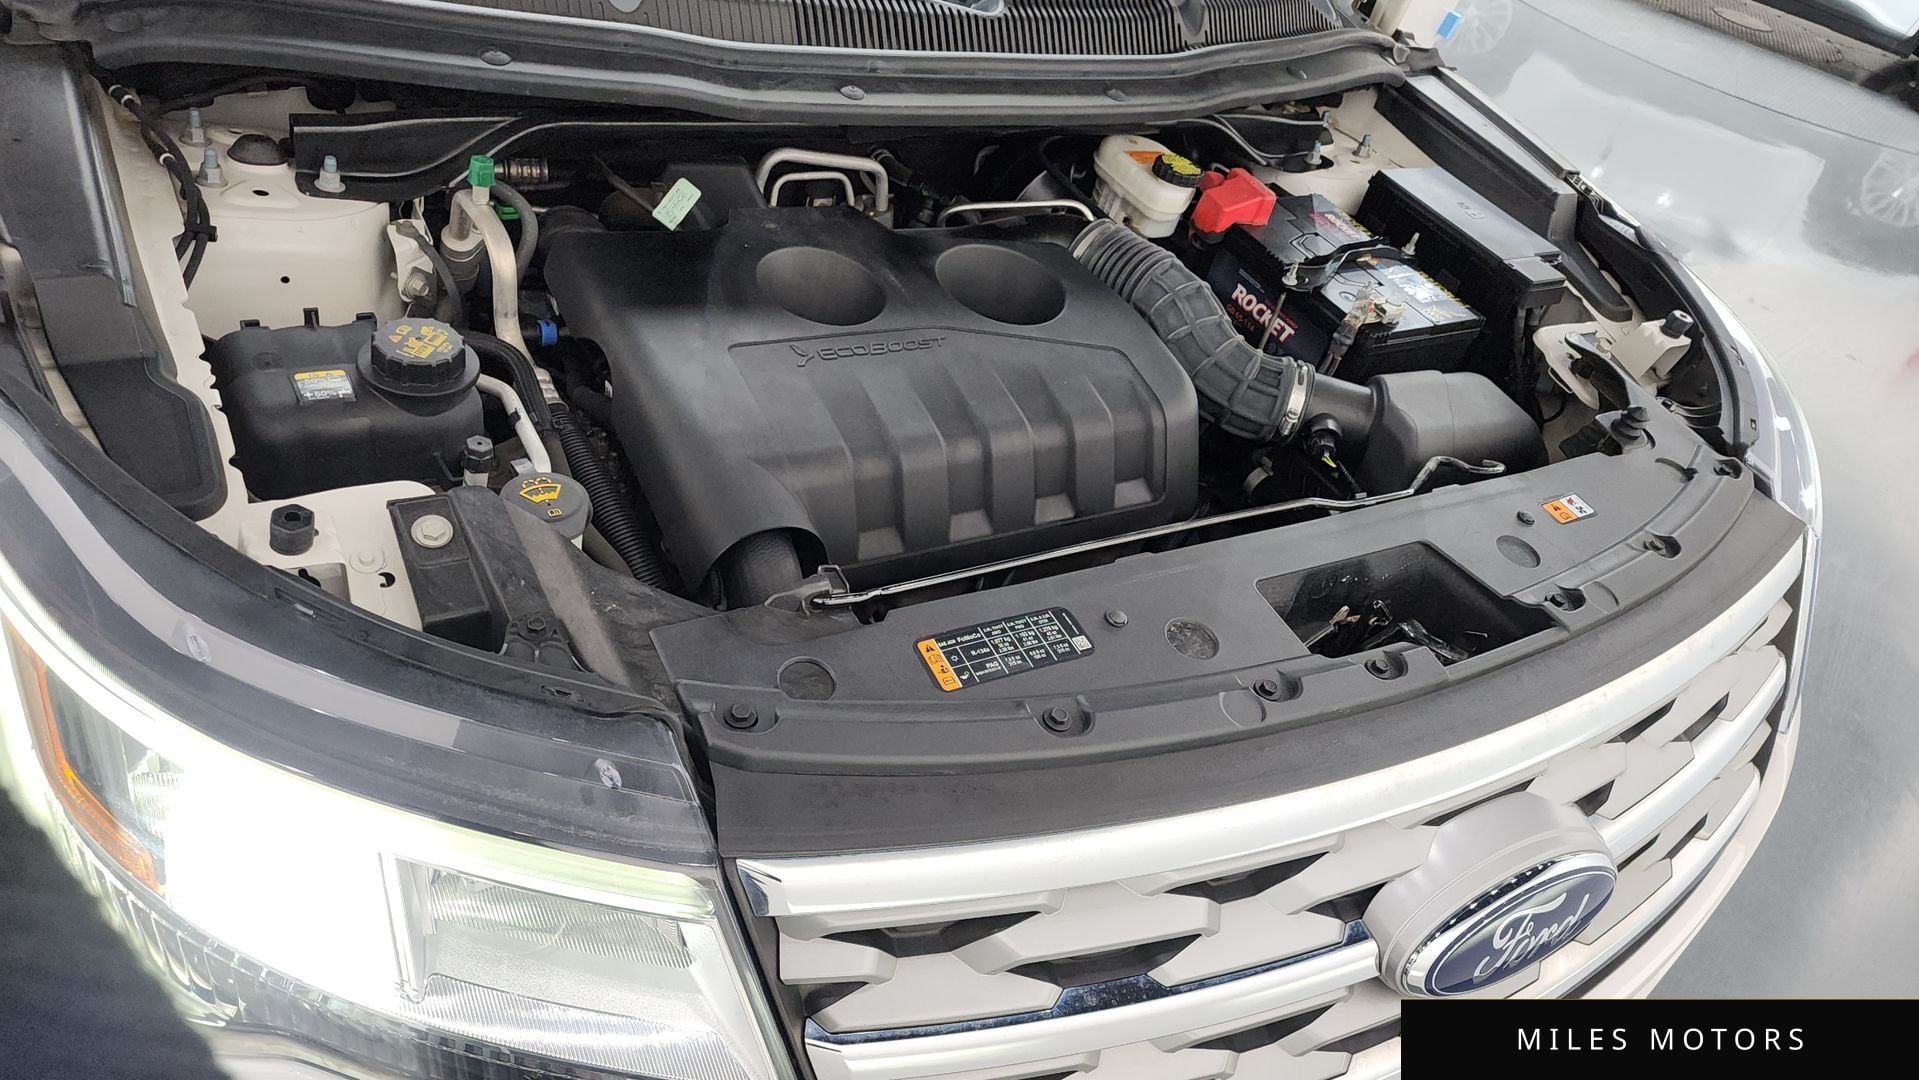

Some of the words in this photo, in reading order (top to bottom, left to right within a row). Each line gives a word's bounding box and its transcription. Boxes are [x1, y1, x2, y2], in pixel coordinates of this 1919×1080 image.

[1231, 282, 1296, 342] ROCKET
[817, 336, 947, 361] ECOBOOST
[956, 633, 981, 642] FoMoCo
[971, 647, 990, 656] R-134a
[985, 661, 999, 669] PAG
[1473, 892, 1590, 984] Ford
